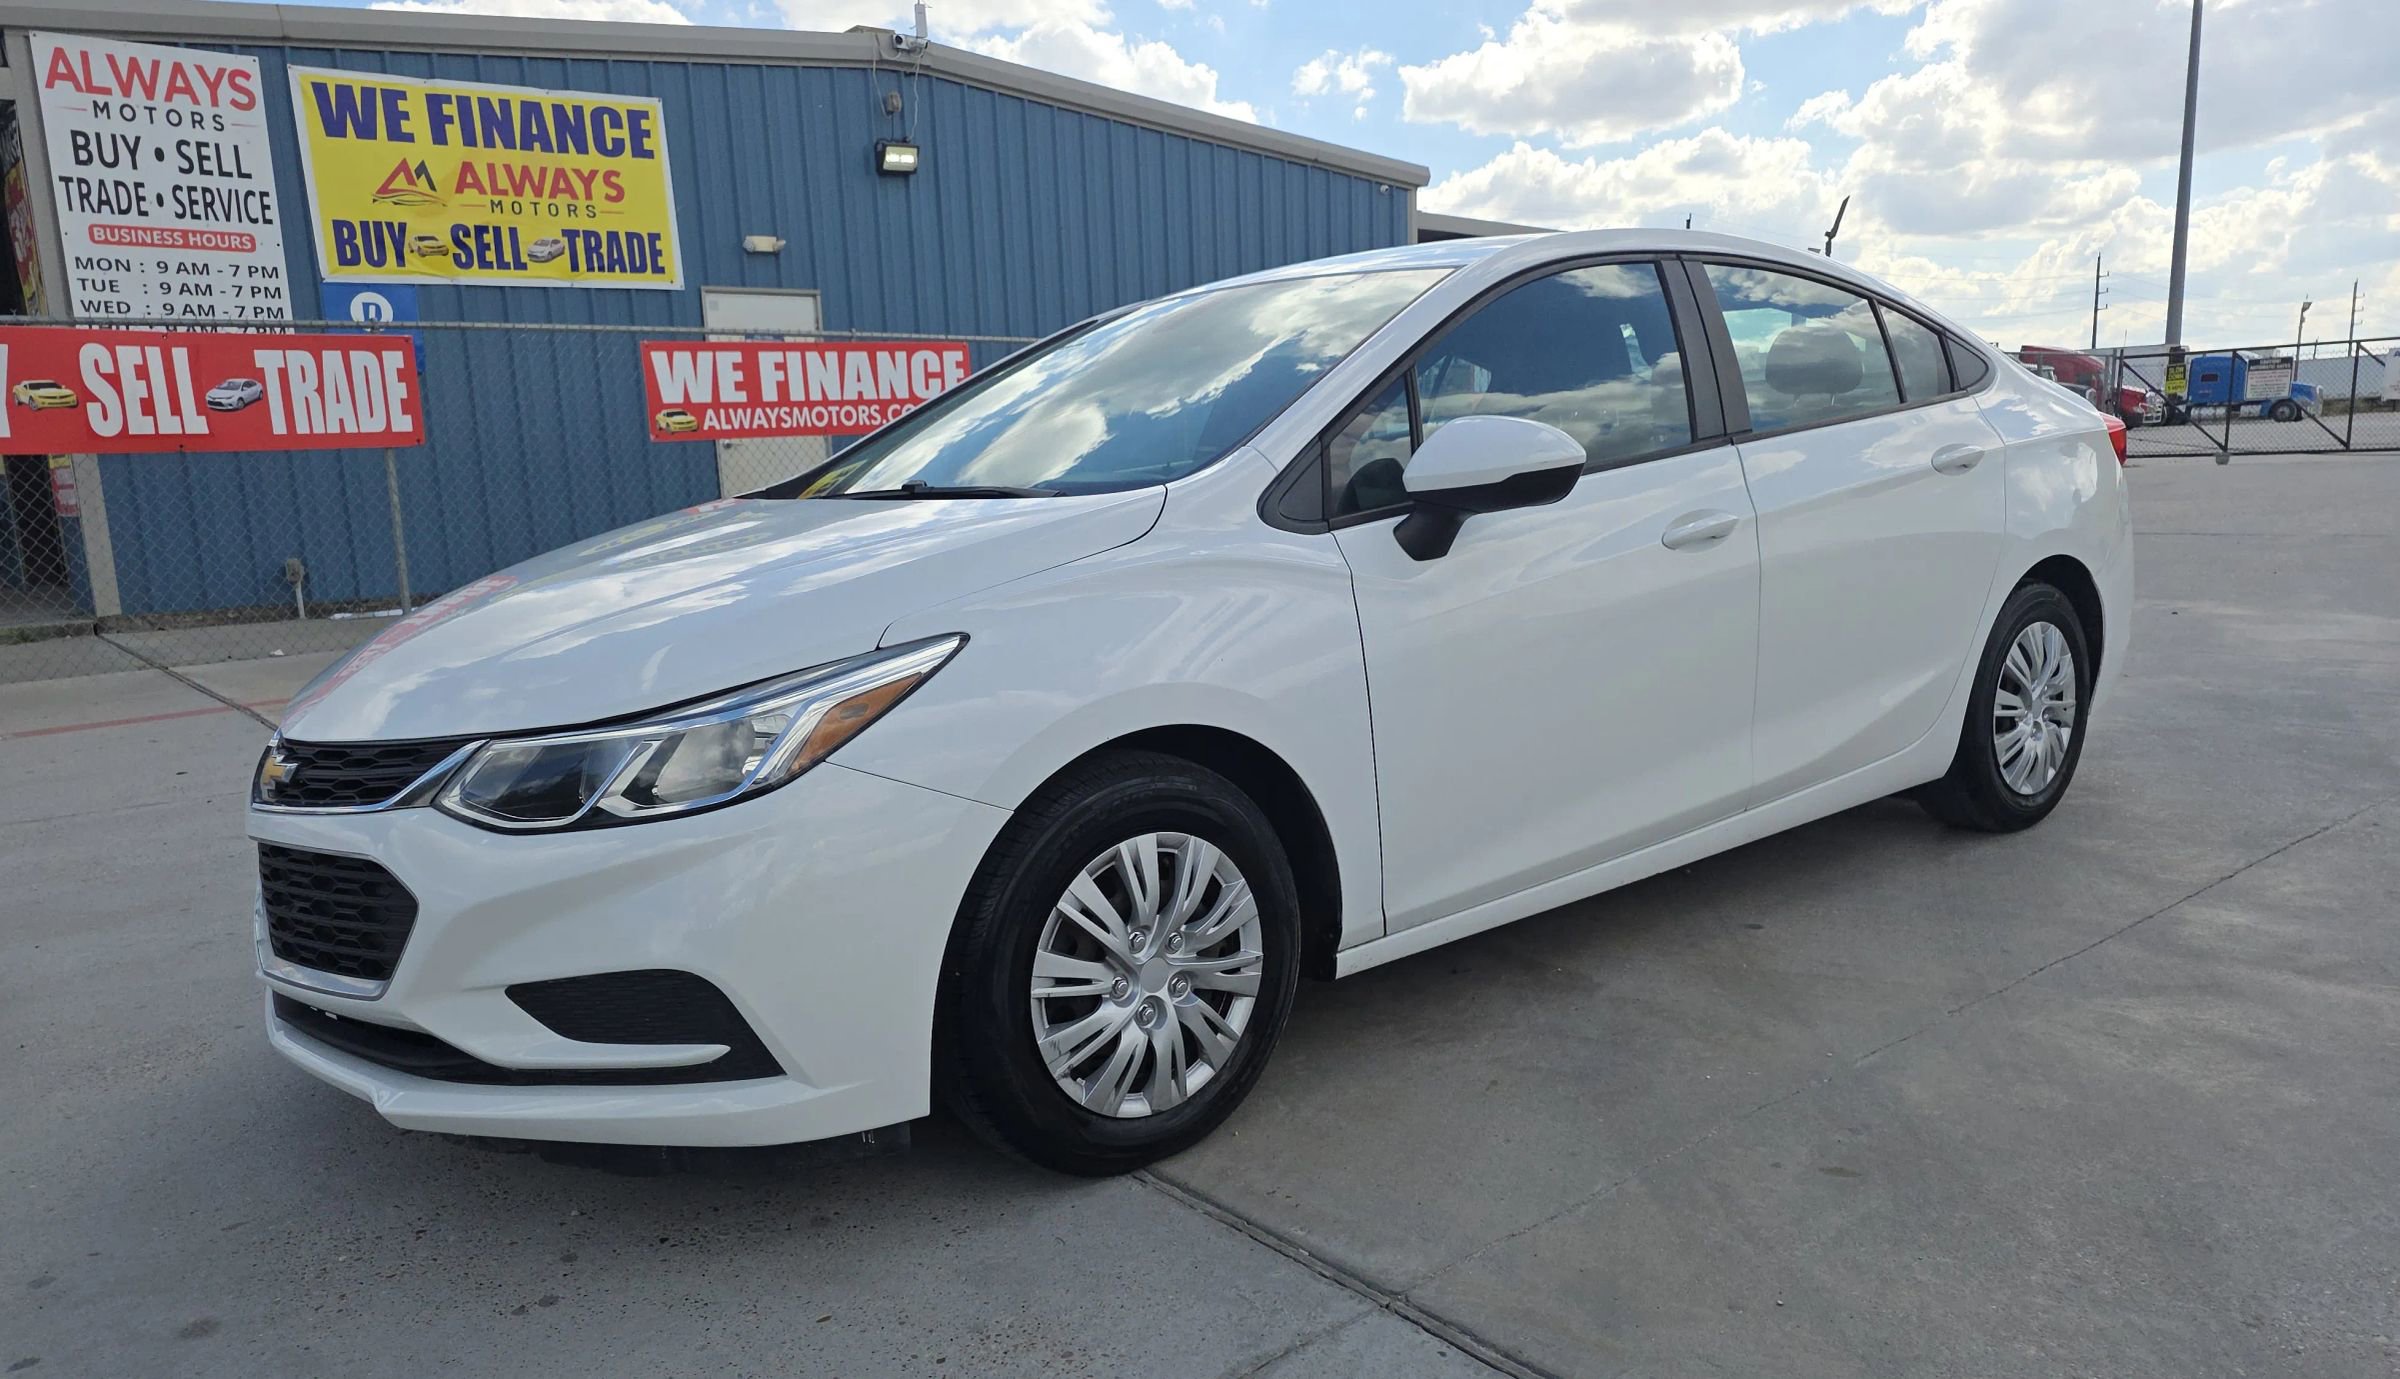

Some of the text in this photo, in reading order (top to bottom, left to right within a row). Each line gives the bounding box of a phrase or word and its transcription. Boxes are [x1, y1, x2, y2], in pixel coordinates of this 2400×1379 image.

[45, 47, 257, 111] ALWAYS
[93, 100, 225, 132] MOTORS
[311, 82, 656, 160] WE FINANCE
[70, 129, 252, 179] BUY SELL
[59, 176, 273, 225] TRADE SERVICE
[455, 161, 625, 204] ALWAYS
[490, 199, 597, 219] MOTORS
[93, 228, 252, 250] BUSINESS HOURS
[332, 219, 666, 275] BUY SELL TRADE
[75, 256, 131, 273] MON
[156, 260, 169, 275] 9
[176, 261, 210, 277] AM
[229, 264, 241, 279] 7
[248, 265, 280, 280] PM
[77, 277, 120, 294] TUE
[159, 282, 172, 296] 9
[179, 282, 213, 297] AM
[231, 285, 244, 299] 7
[251, 285, 282, 300] PM
[80, 299, 131, 315] WED
[162, 303, 175, 317] 9
[182, 303, 215, 318] AM
[235, 305, 247, 319] 7
[254, 306, 285, 320] PM
[79, 343, 209, 438] SELL
[253, 349, 413, 435] TRADE
[650, 349, 965, 404] WE FINANCE
